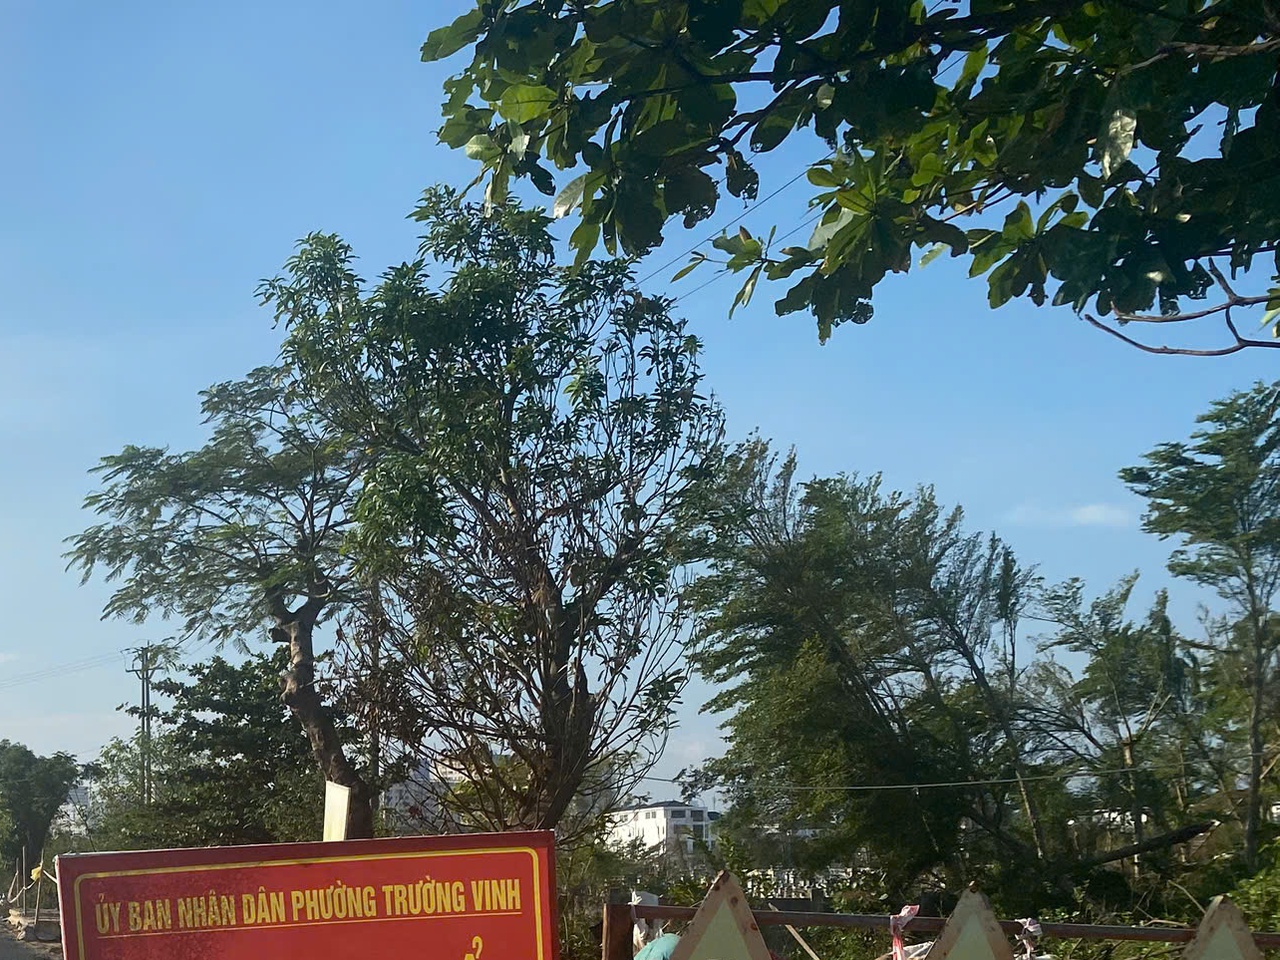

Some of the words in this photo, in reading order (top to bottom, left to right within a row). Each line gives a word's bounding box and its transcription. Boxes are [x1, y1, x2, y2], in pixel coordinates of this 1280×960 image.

[95, 892, 121, 934] ỦY
[128, 899, 174, 932] BAN
[177, 889, 236, 927] NHÂN
[242, 886, 286, 926] DÂN
[291, 880, 377, 921] PHƯỜNG
[382, 875, 466, 916] TRƯỜNG
[471, 879, 521, 911] VINH
